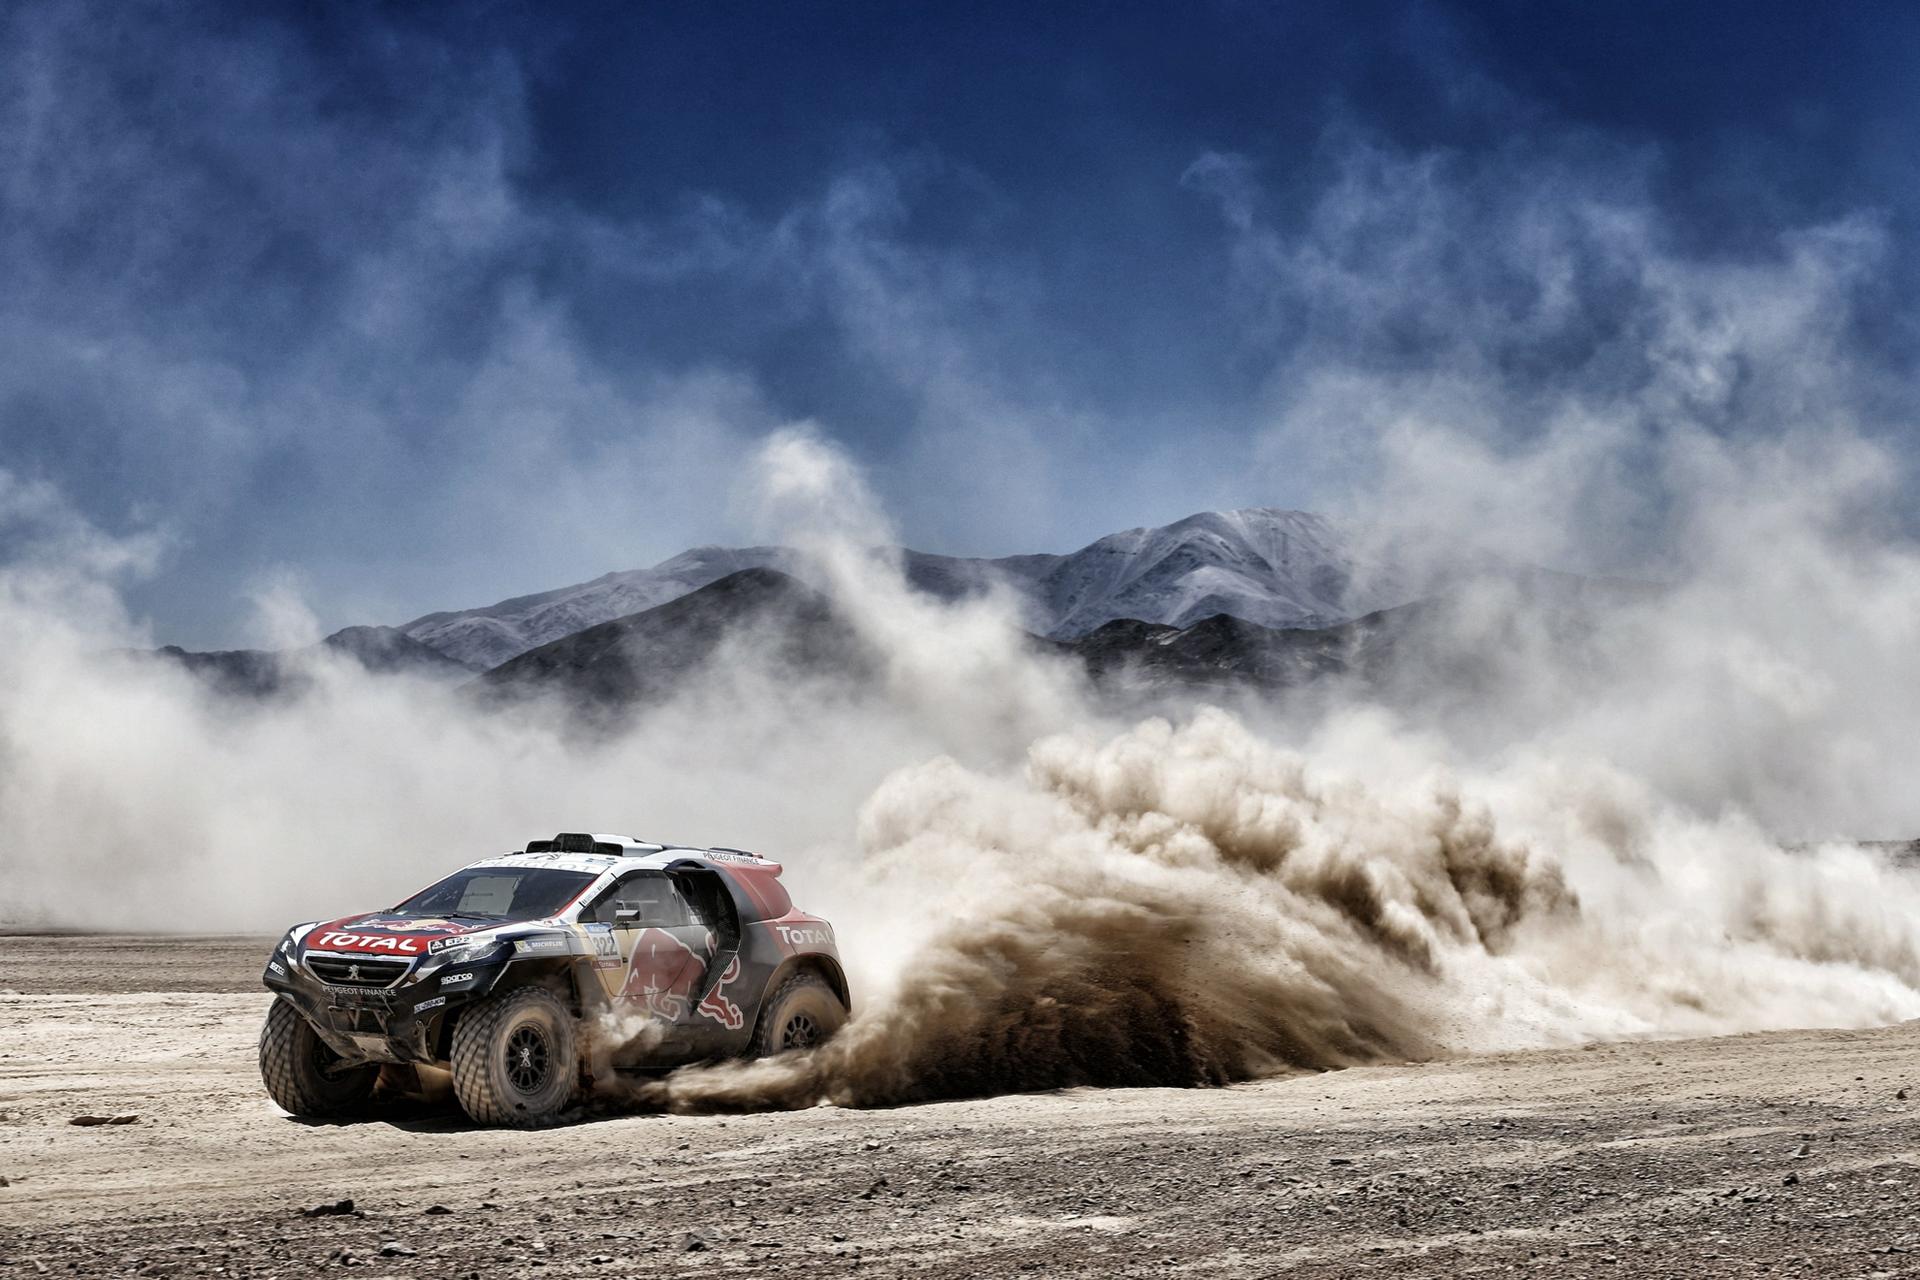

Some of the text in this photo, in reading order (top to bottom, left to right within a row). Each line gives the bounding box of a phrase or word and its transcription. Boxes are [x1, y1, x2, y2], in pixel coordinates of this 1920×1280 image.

[319, 931, 417, 951] TOTAL
[776, 926, 836, 945] TOTAL
[531, 940, 563, 949] MICHELIN
[593, 936, 618, 956] 322
[440, 972, 473, 986] sparco
[321, 985, 397, 997] PEUGEOT FINANCE
